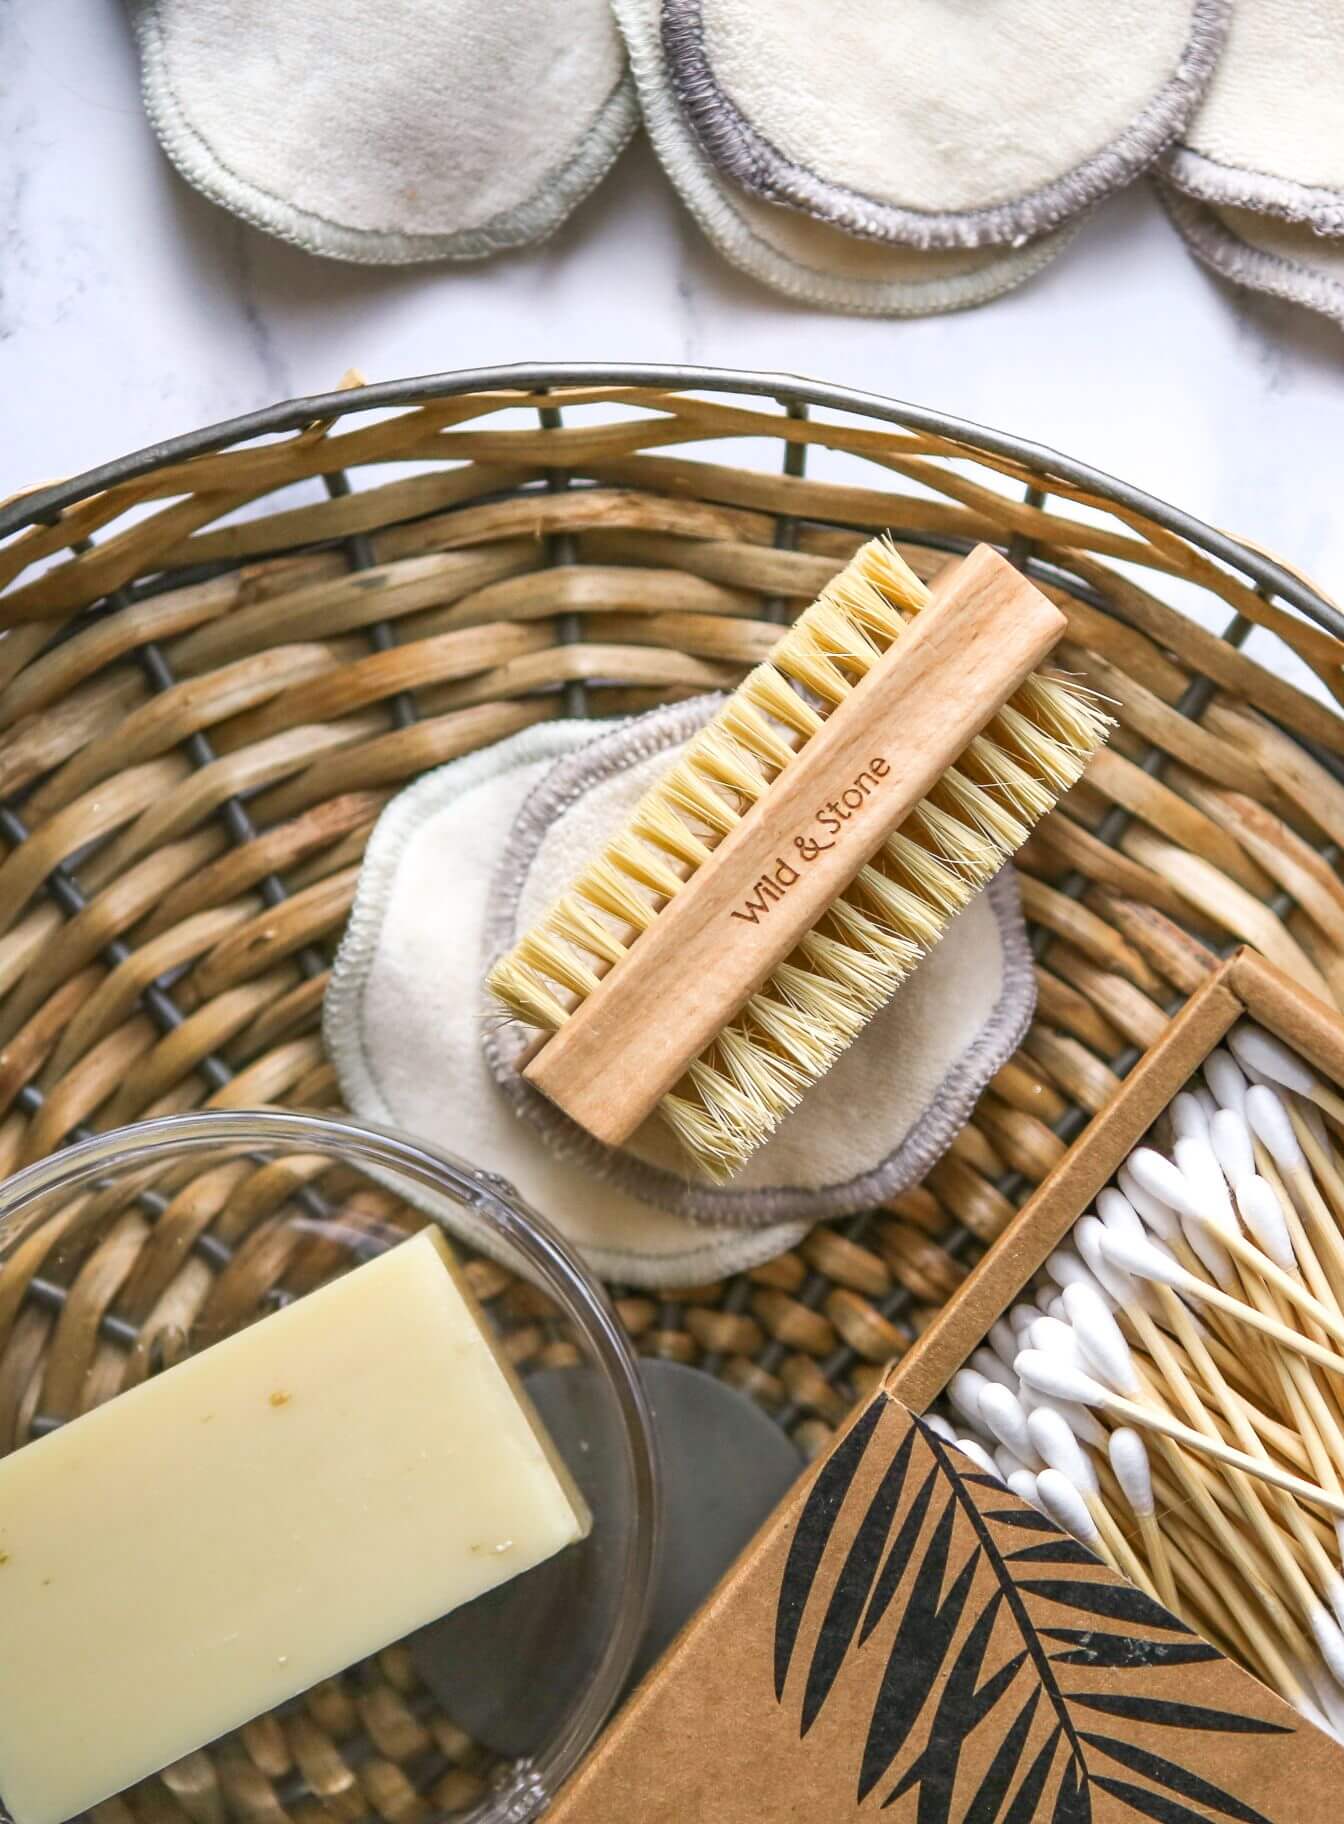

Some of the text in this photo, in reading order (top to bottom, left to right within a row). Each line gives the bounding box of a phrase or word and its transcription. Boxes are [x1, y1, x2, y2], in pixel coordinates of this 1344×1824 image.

[730, 757, 891, 925] Wild & Stone
